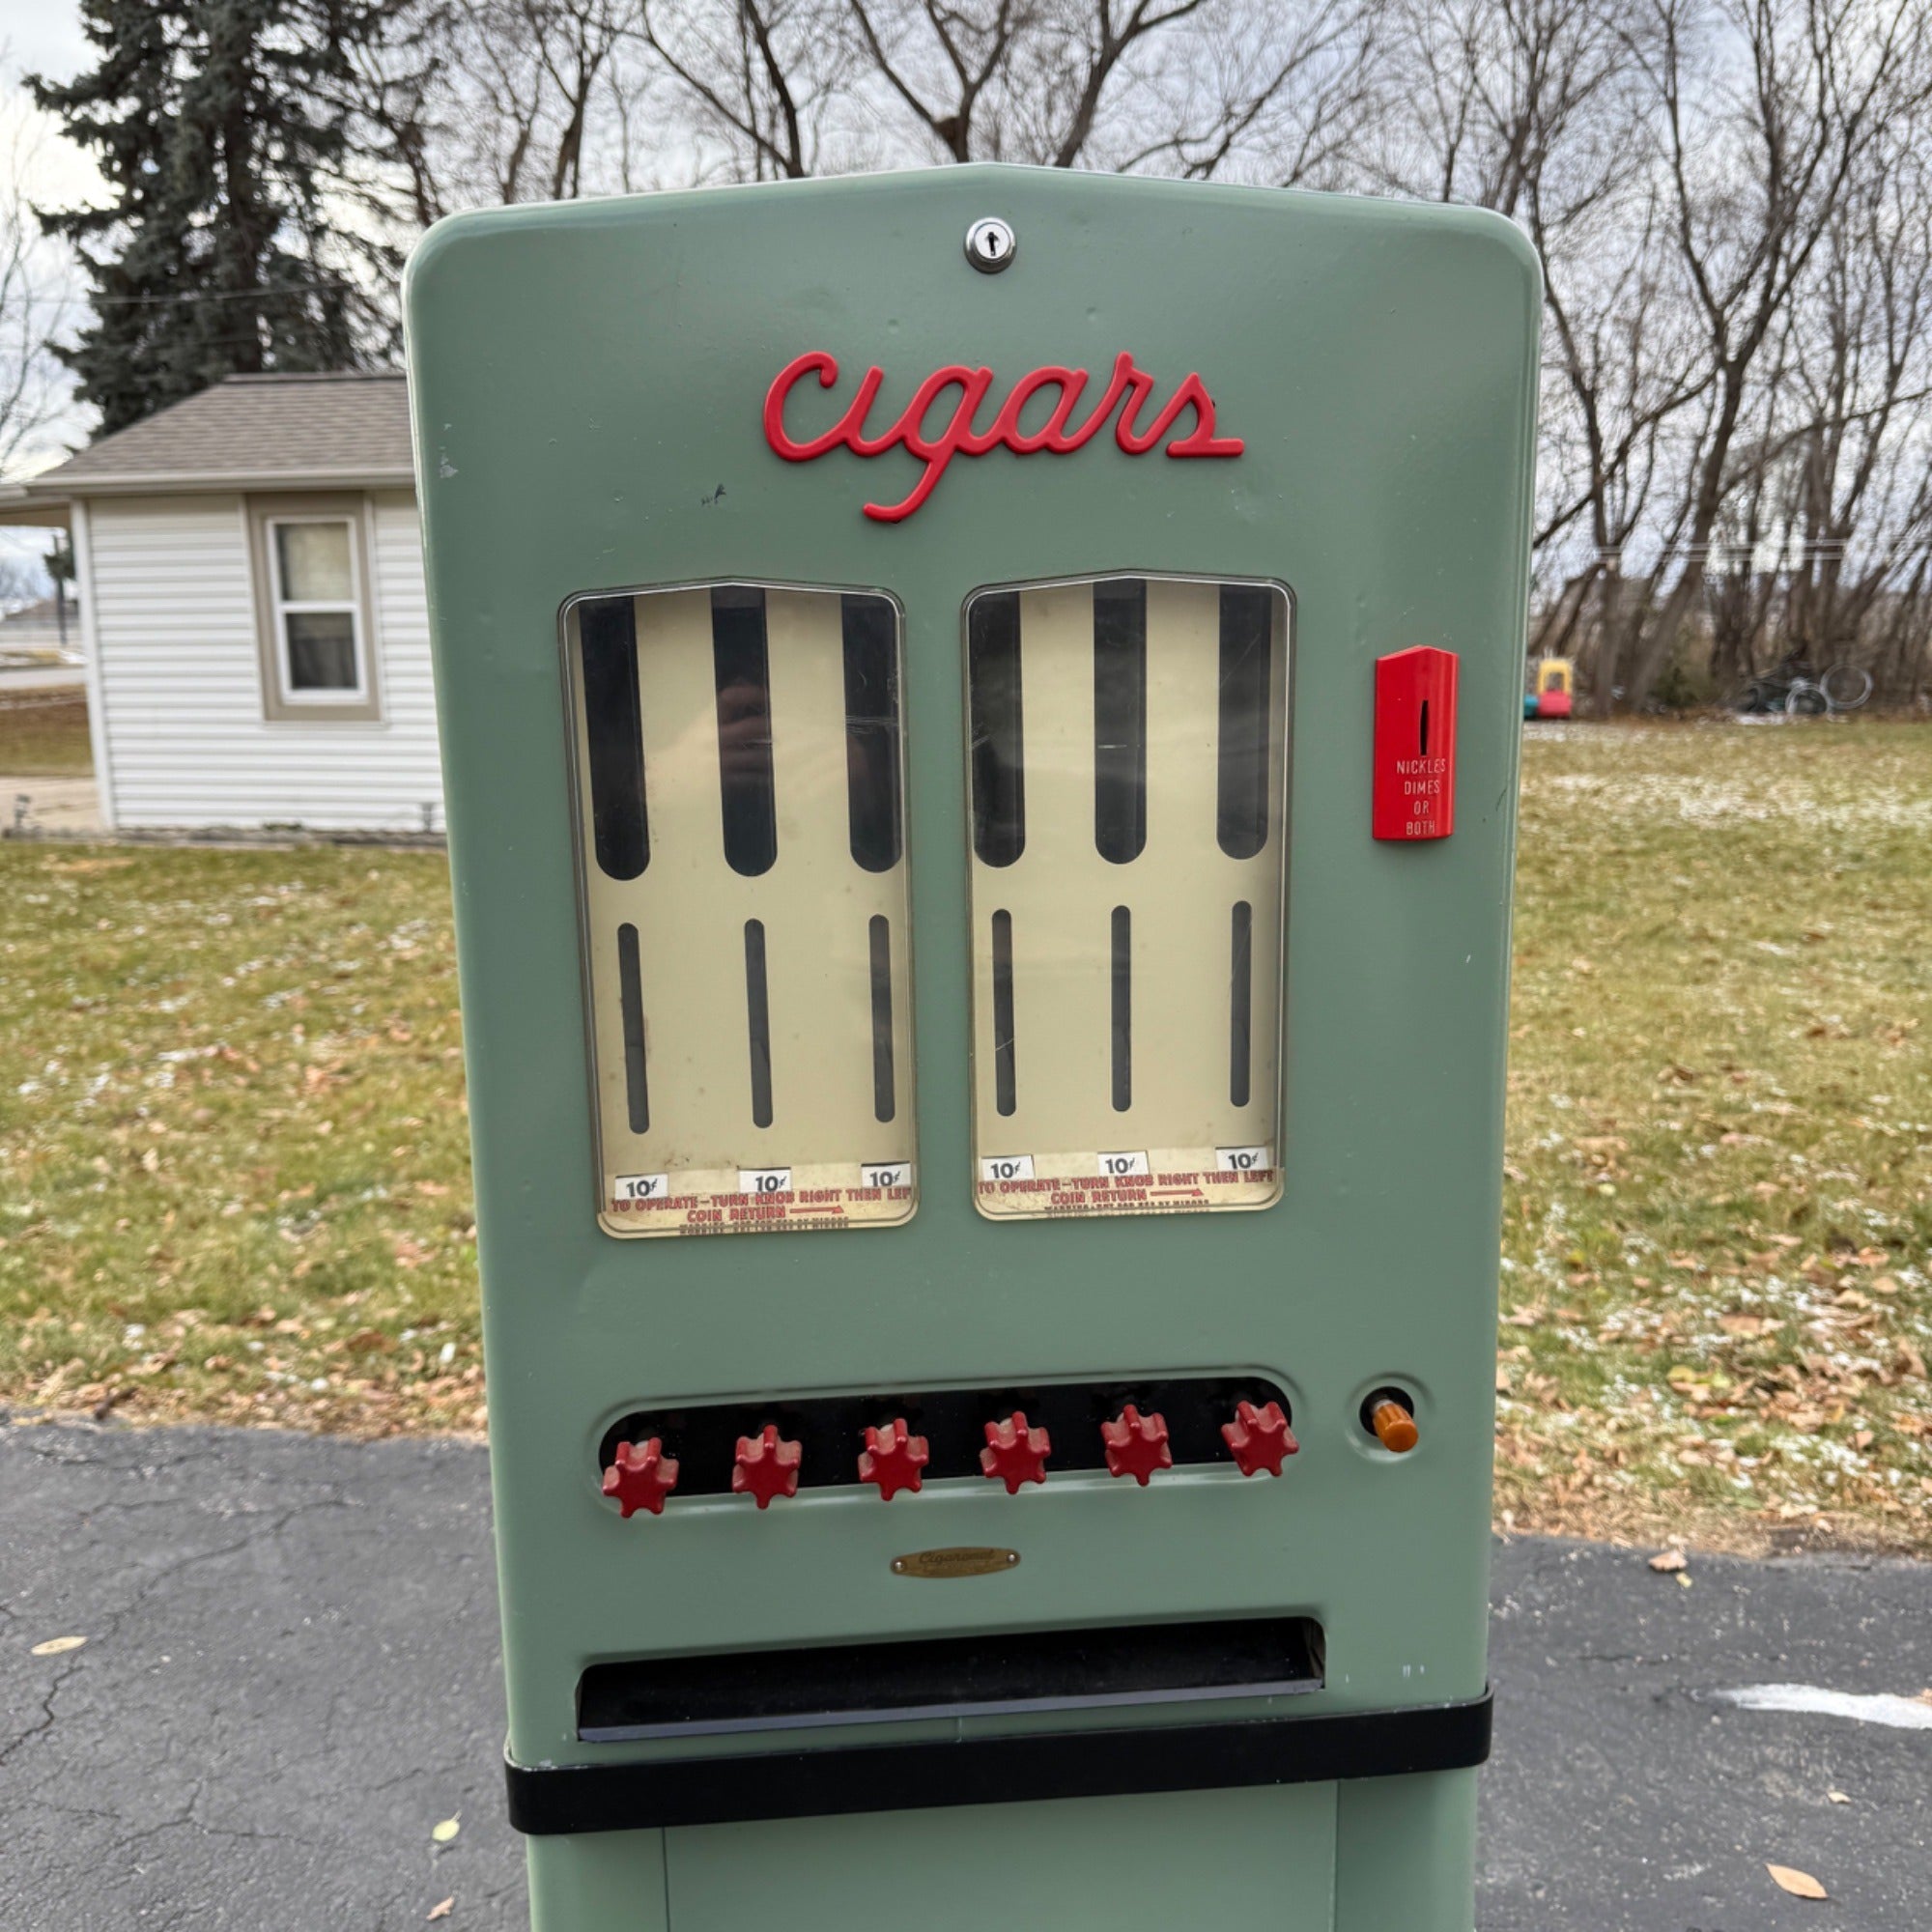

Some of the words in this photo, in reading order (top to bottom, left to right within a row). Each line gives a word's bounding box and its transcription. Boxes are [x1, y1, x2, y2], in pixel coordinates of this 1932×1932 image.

[1396, 758, 1446, 775] NICKLES
[1404, 780, 1440, 795] DIMES
[1413, 800, 1430, 815] OR
[1406, 820, 1435, 836] BOTH
[978, 1180, 995, 1195] TO
[1115, 1174, 1153, 1188] KNOB
[1157, 1172, 1199, 1186] RIGHT
[1203, 1170, 1238, 1184] THEN
[1243, 1169, 1273, 1183] LEFT
[611, 1199, 631, 1212] TO
[754, 1191, 795, 1206] KNOB
[799, 1189, 842, 1203] RIGHT
[846, 1187, 881, 1202] THEN
[887, 1187, 912, 1200] LEF
[1050, 1191, 1086, 1206] COIN
[1092, 1187, 1148, 1204] RETURN
[687, 1208, 723, 1223] COIN
[729, 1206, 785, 1221] RETURN
